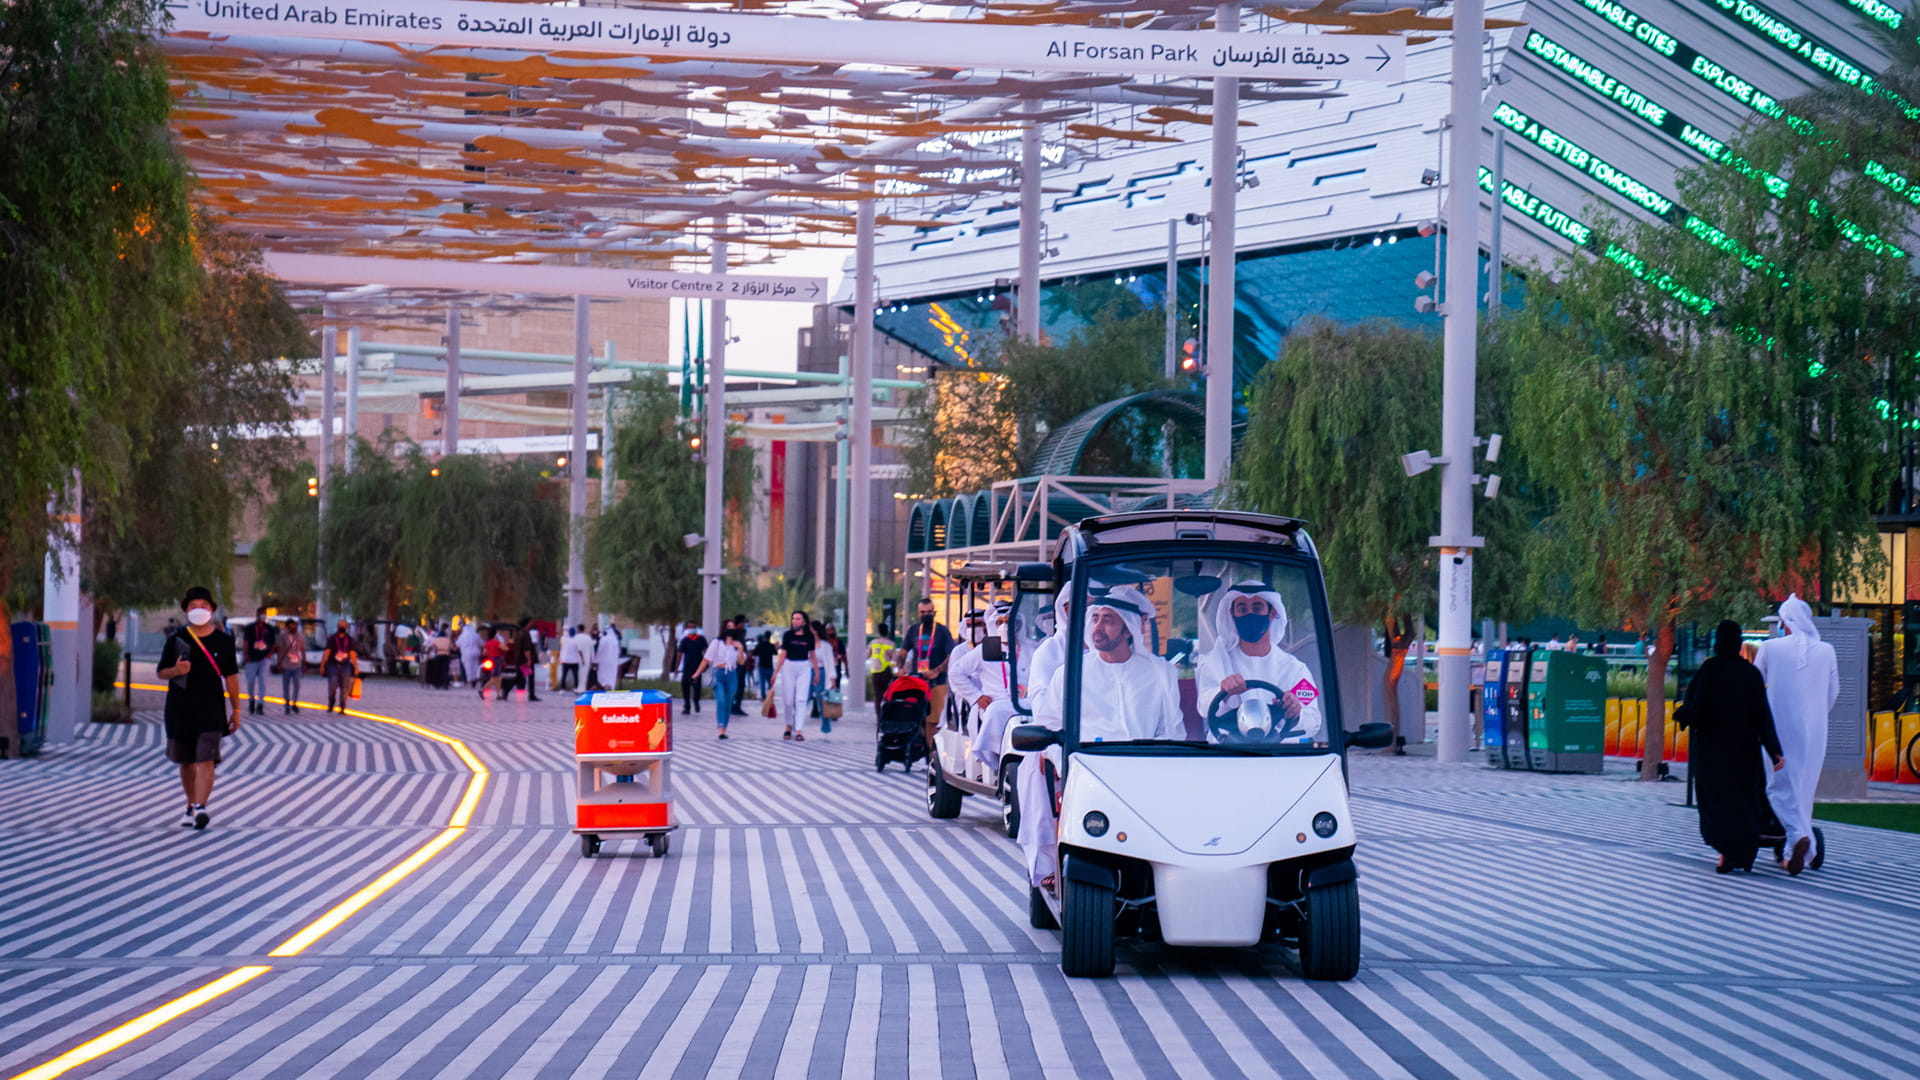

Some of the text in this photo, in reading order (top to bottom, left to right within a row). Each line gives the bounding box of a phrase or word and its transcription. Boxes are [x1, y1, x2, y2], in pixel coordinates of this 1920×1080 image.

[204, 0, 442, 30] United Arab Emirates
[457, 13, 731, 48] دولة الإمارات العربية المتحدة
[1046, 40, 1198, 62] Al Forsan Park
[1635, 22, 1677, 56] CITIES
[1734, 0, 1861, 86] TOWARDS A BETTER
[1212, 45, 1350, 70] حديقة الفرسان
[1691, 56, 1754, 102] EXPLORE
[1526, 33, 1617, 95] SUSTAINABLE
[1613, 84, 1668, 126] FUTURE
[1681, 124, 1724, 160] MAKE
[1523, 123, 1539, 140] A
[1537, 128, 1590, 169] BETTER
[1588, 157, 1673, 216] TOMORROW
[1536, 203, 1592, 245] FUTURE
[627, 278, 724, 292] Visitor Centre 2
[731, 282, 739, 292] 2
[772, 283, 797, 296] مركز
[602, 713, 641, 724] talabat
